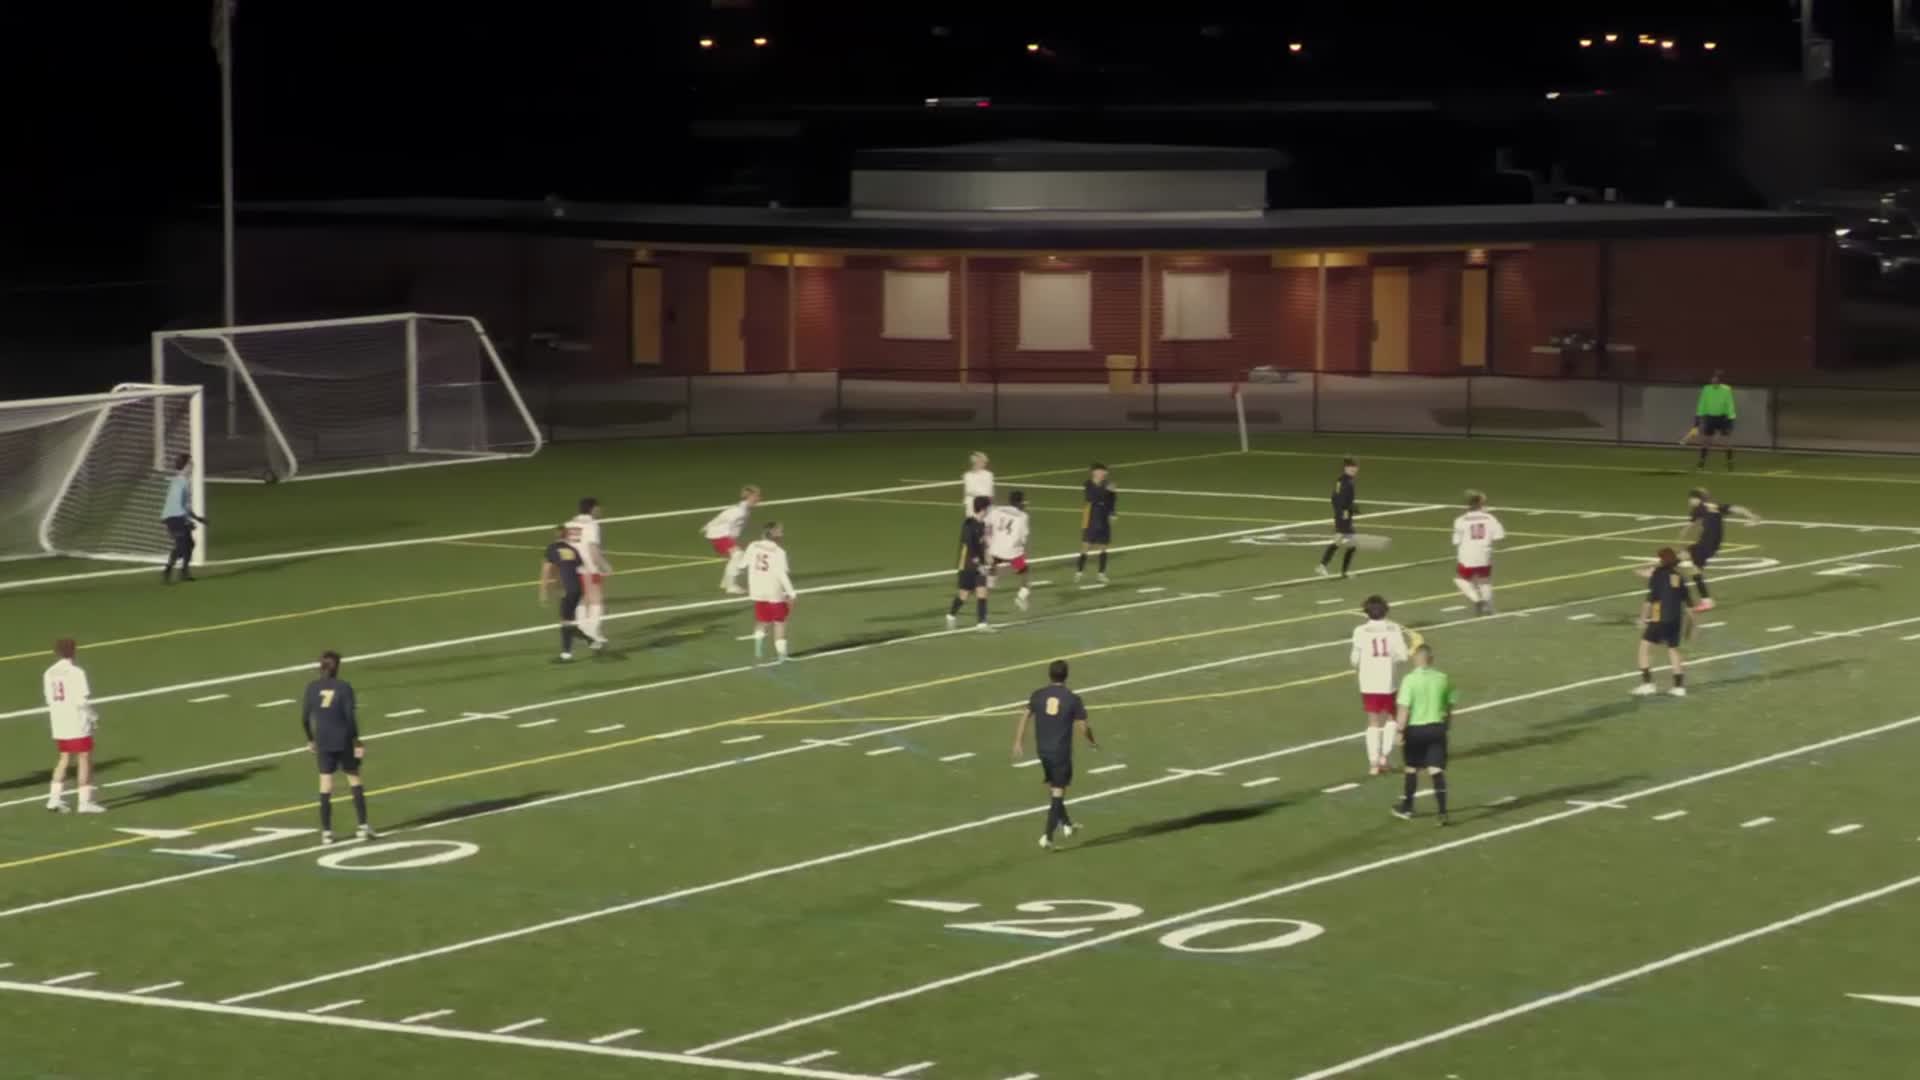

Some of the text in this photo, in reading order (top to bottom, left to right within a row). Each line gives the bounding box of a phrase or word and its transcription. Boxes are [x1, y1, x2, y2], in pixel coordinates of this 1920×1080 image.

[1372, 637, 1389, 657] 11
[319, 689, 335, 708] 7
[944, 898, 1326, 954] 20
